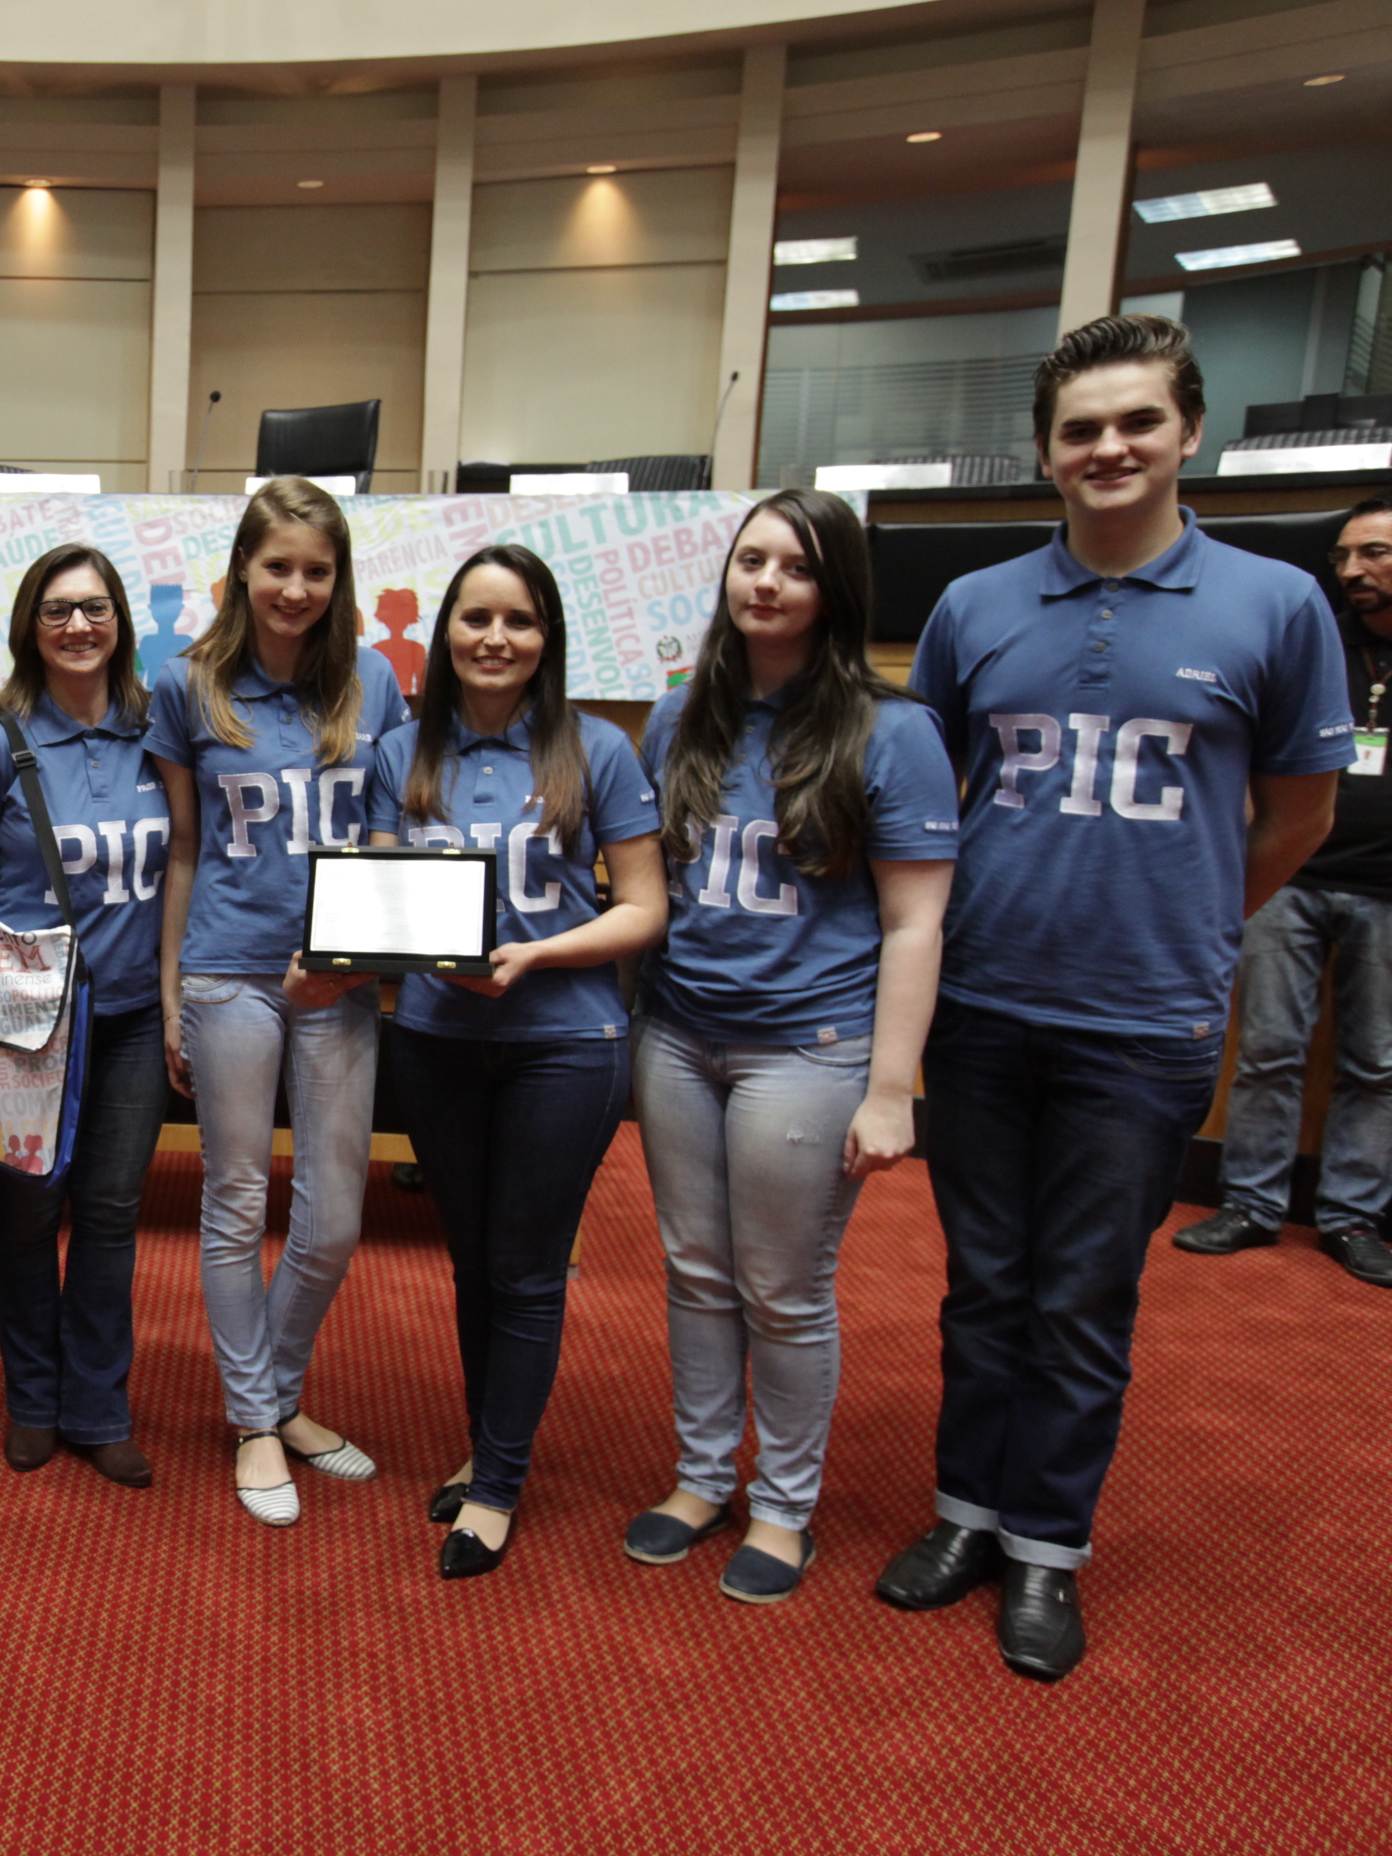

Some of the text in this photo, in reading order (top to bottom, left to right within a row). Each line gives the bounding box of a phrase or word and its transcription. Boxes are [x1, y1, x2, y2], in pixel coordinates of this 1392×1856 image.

[626, 511, 747, 574] DEBAT
[595, 548, 644, 667] POLÍTICA
[988, 712, 1194, 821] PIC
[217, 768, 365, 857] PIC
[44, 817, 169, 905] PIC
